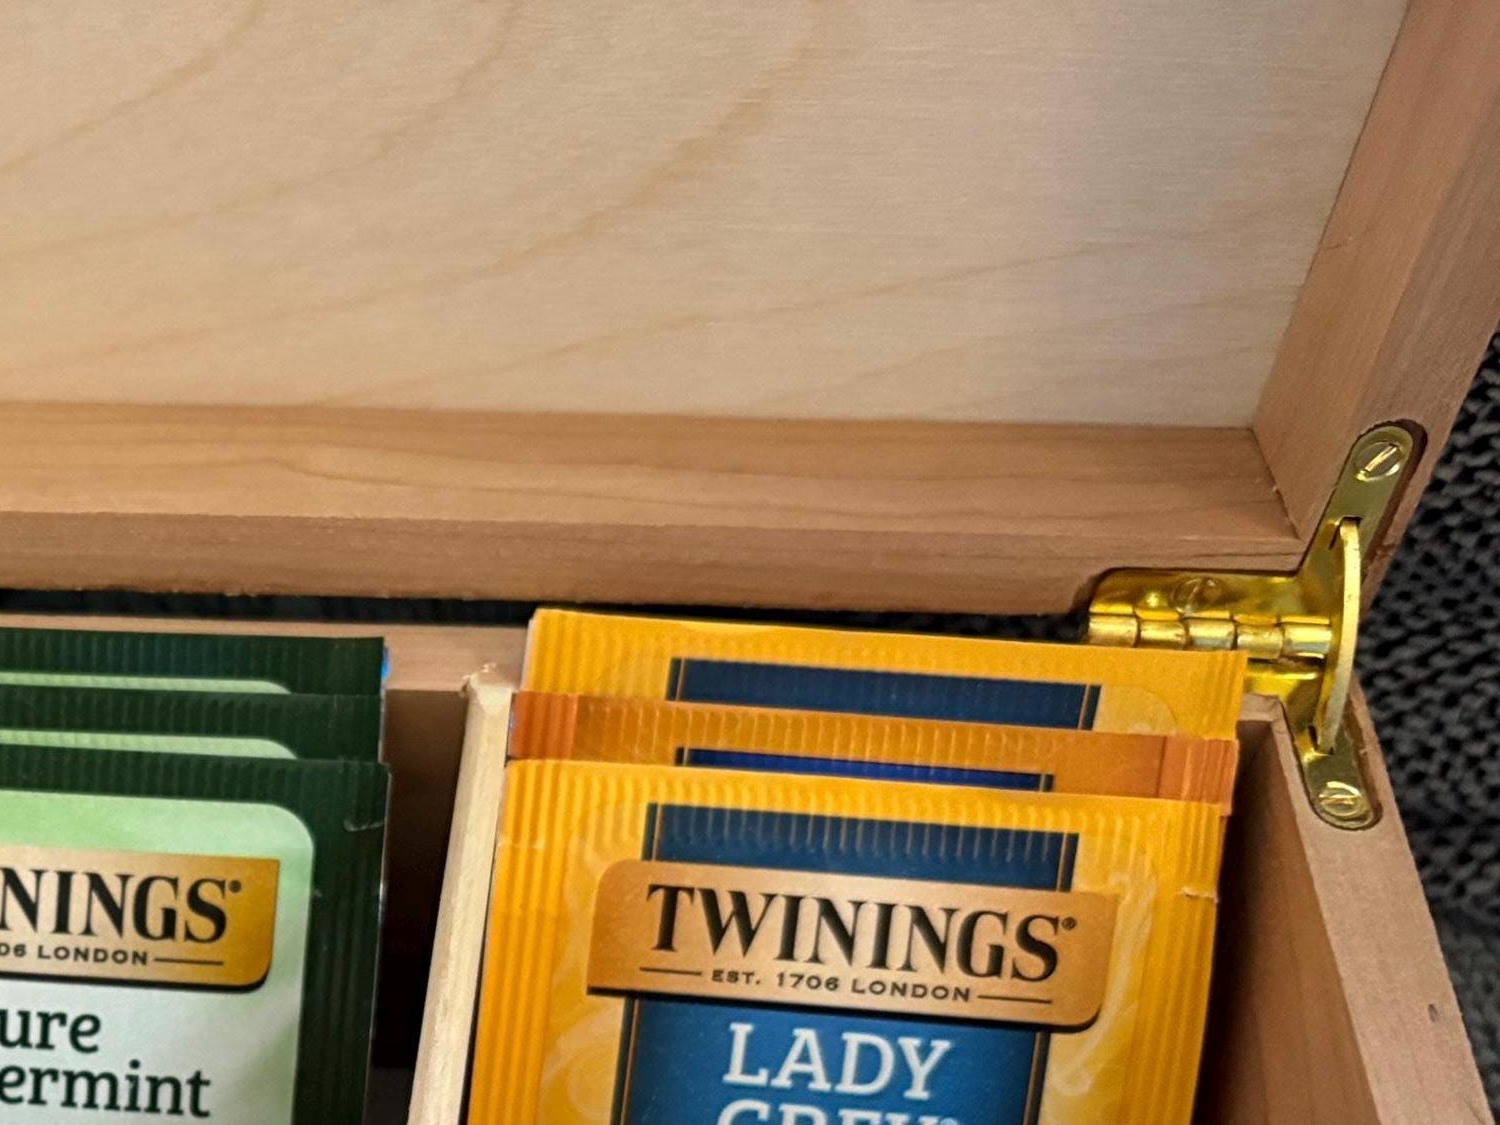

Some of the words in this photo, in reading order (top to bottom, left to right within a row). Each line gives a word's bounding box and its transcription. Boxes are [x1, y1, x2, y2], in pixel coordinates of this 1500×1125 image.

[36, 944, 149, 967] LONDON
[711, 968, 762, 986] EST.
[775, 971, 840, 992] 1706
[850, 979, 972, 1003] LONDON
[721, 1021, 955, 1101] LADY
